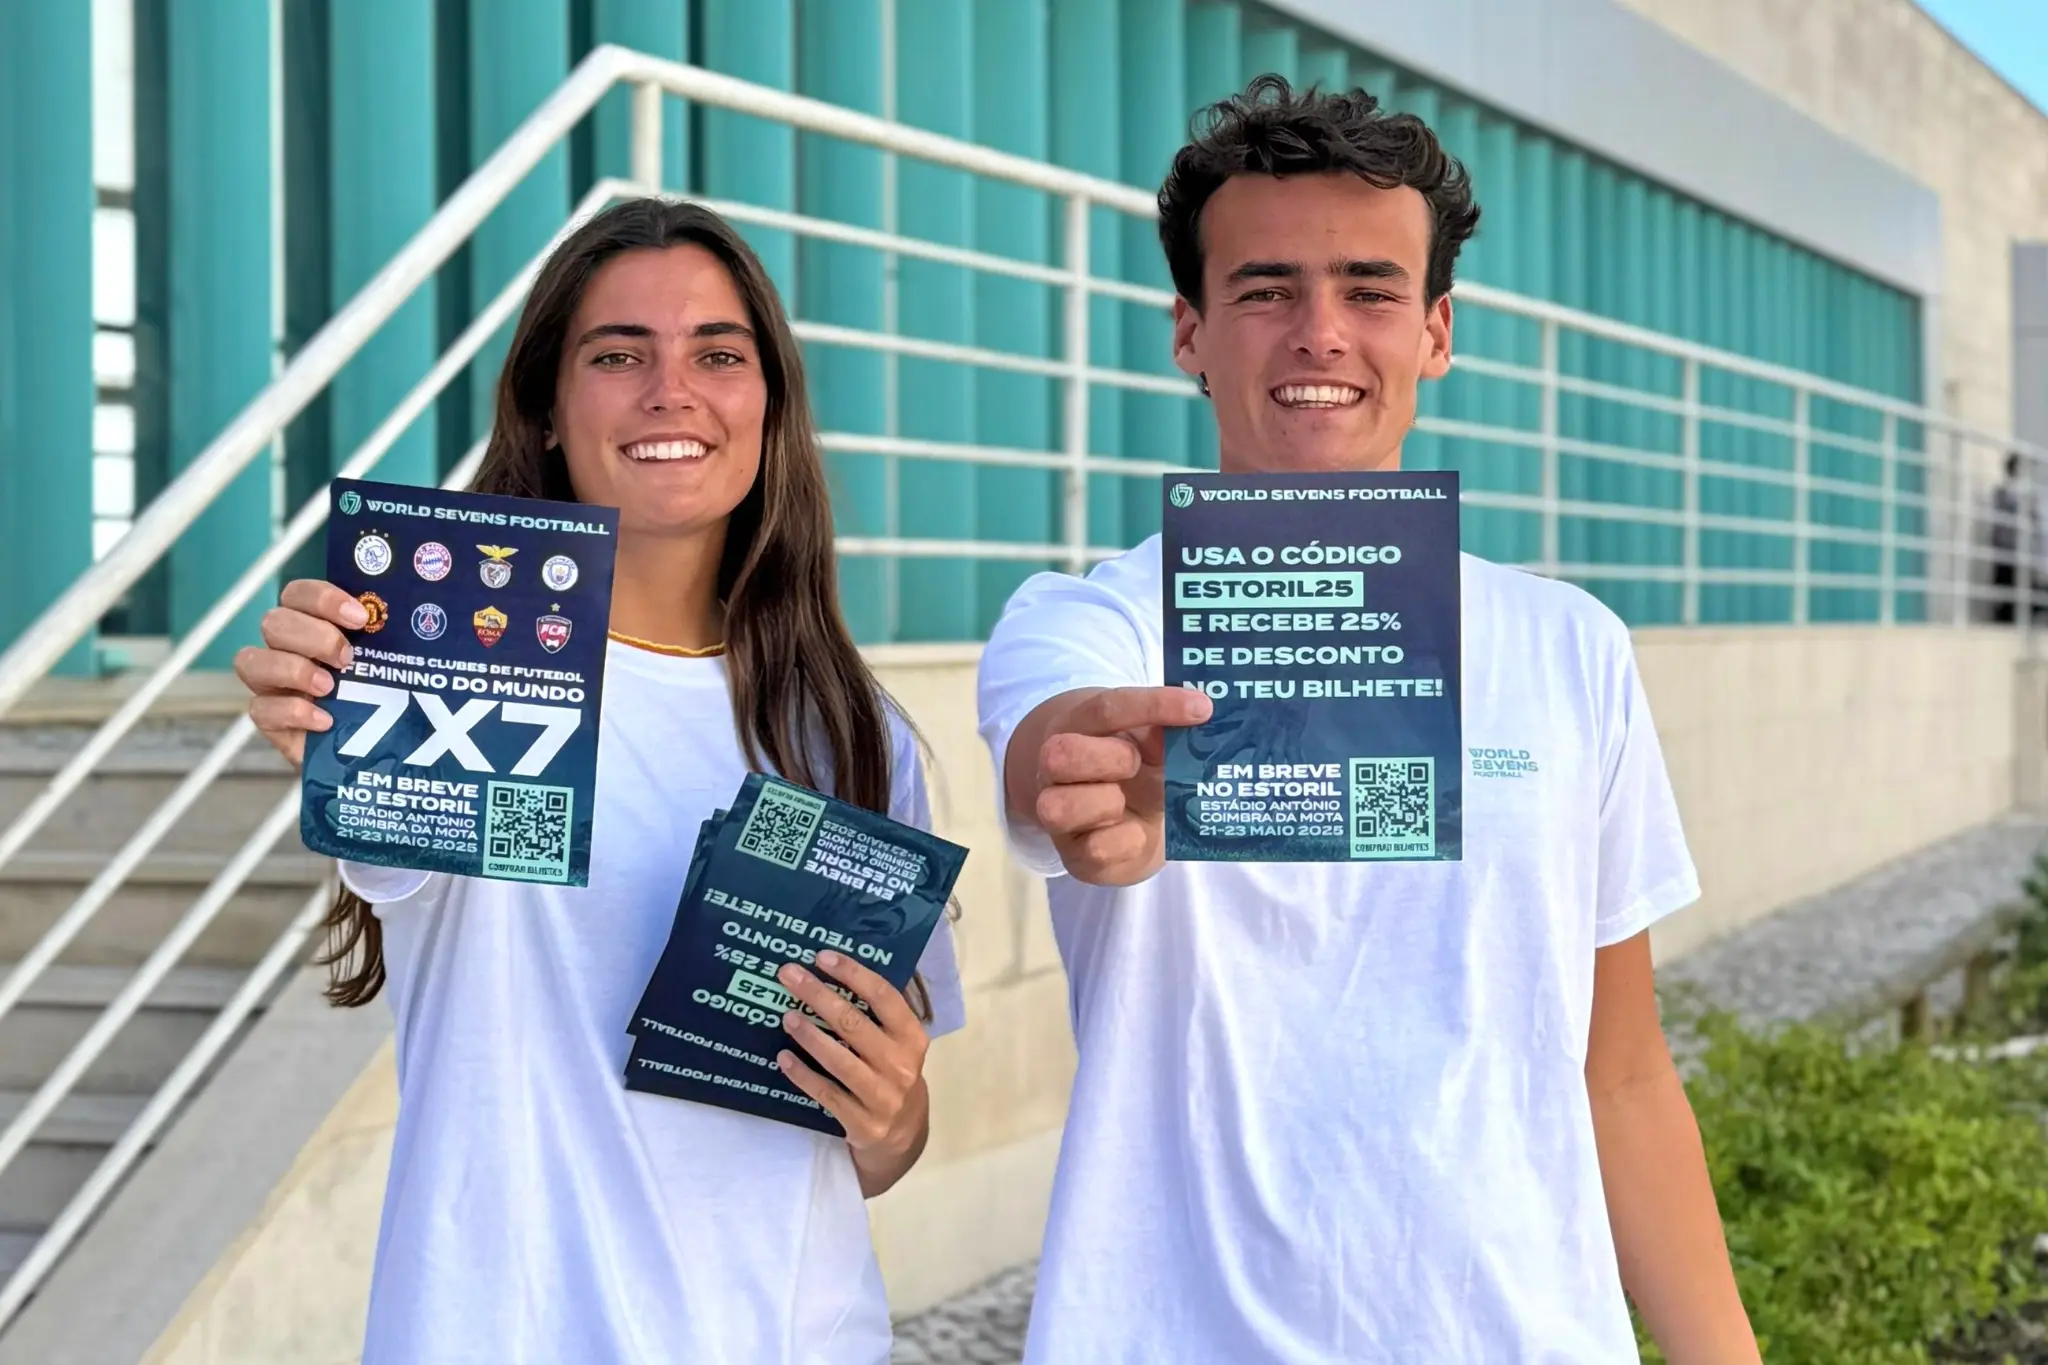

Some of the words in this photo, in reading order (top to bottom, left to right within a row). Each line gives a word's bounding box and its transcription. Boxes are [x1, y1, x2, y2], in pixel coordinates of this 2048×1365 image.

[1199, 489, 1268, 501] WORLD
[1271, 489, 1346, 501] SEVENS
[1348, 488, 1447, 500] FOOTBALL
[366, 499, 431, 518] WORLD
[434, 507, 507, 526] SEVENS
[509, 515, 610, 535] FOOTBALL
[1182, 546, 1246, 566] USA
[1251, 546, 1275, 565] O
[1280, 540, 1402, 565] CÓDIGO
[1182, 579, 1355, 599] ESTORIL25
[1182, 614, 1203, 632] E
[1208, 613, 1335, 632] RECEBE
[1341, 612, 1402, 631] 25%
[365, 647, 425, 667] MAIORES
[427, 657, 488, 674] CLUBES
[489, 664, 512, 676] DE
[513, 667, 585, 683] FUTEBOL
[1182, 647, 1225, 666] DE
[1231, 645, 1405, 665] DESCONTO
[340, 660, 448, 690] FEMININO
[452, 675, 489, 694] DO
[492, 680, 585, 703] MUNDO
[1233, 680, 1296, 699] TEU
[1303, 679, 1443, 698] BILHETE!
[336, 679, 582, 777] 7X7
[1468, 746, 1530, 760] WORLD
[1216, 764, 1256, 780] EM
[1258, 763, 1342, 779] BREVE
[1472, 759, 1539, 772] SEVENS
[356, 771, 392, 789] EM
[396, 776, 479, 798] BREVE
[1197, 782, 1235, 798] NO
[1237, 781, 1342, 797] ESTORIL
[337, 785, 374, 802] NO
[376, 792, 479, 816] ESTORIL
[1200, 798, 1267, 812] ESTÁDIO
[1269, 797, 1341, 811] ANTÓNIO
[339, 803, 403, 821] ESTÁDIO
[405, 811, 476, 828] ANTÓNIO
[1200, 812, 1274, 823] COIMBRA
[1276, 811, 1297, 822] DA
[1300, 811, 1344, 822] MOTA
[338, 815, 408, 834] COIMBRA
[411, 823, 431, 836] DA
[435, 827, 479, 840] MOTA
[819, 830, 850, 846] MOTA
[823, 820, 859, 838] 2025
[1199, 825, 1247, 836] 21-23
[1250, 824, 1295, 836] MAIO
[1297, 824, 1344, 836] 2025
[336, 826, 382, 843] 21-23
[385, 833, 431, 848] MAIO
[434, 838, 479, 853] 2025
[817, 839, 868, 861] ANTÓNIO
[852, 841, 868, 854] DA
[857, 833, 890, 850] MAIO
[812, 848, 886, 882] ESTORIL
[869, 847, 921, 873] COIMBRA
[804, 860, 866, 890] BREVE
[887, 877, 915, 895] NO
[866, 882, 895, 901] EM
[704, 888, 809, 935] BILHETE!
[722, 921, 817, 964] SCONTO
[809, 926, 854, 952] TEU
[713, 944, 761, 970] 25%
[857, 943, 893, 966] NO
[692, 988, 781, 1028] CÓDIGO
[641, 1017, 712, 1049] FOOTBALL
[713, 1043, 768, 1067] SEVENS
[638, 1058, 712, 1082] FOOTBALL
[713, 1075, 770, 1095] SEVENS
